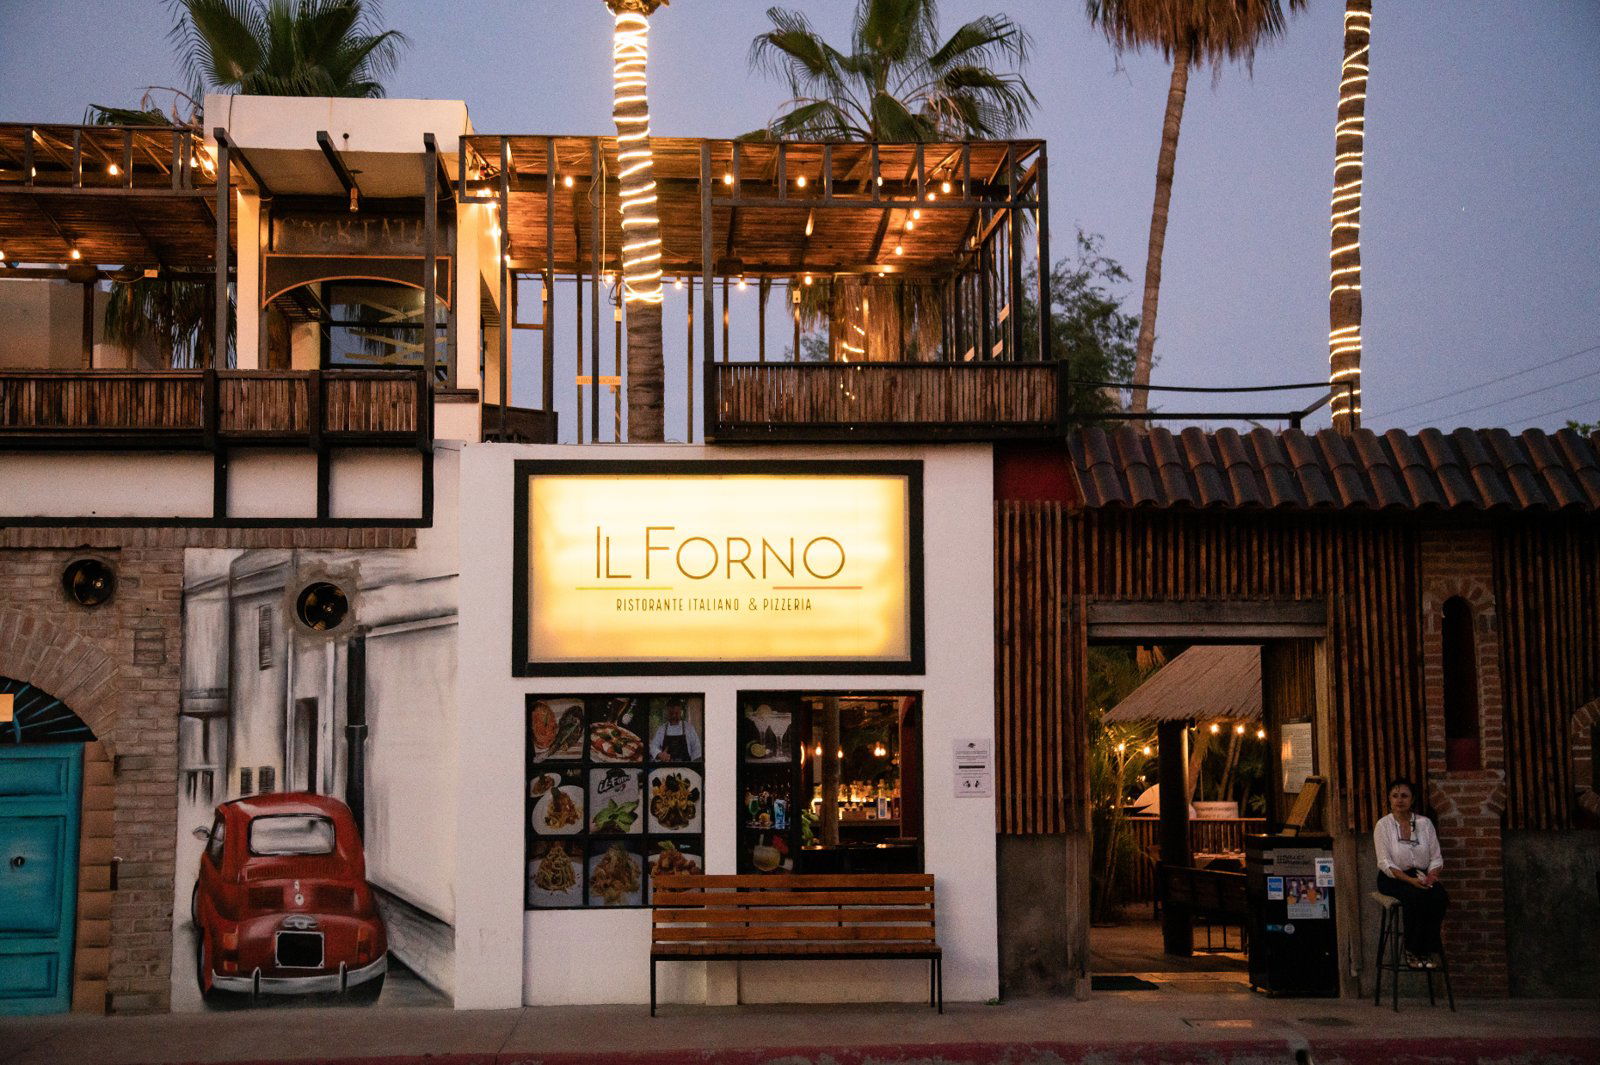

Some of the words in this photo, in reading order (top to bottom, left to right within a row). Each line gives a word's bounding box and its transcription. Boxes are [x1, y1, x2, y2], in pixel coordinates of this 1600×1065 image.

[596, 526, 632, 579] IL
[645, 526, 846, 580] FORNO
[616, 598, 684, 612] RISTORANTE
[688, 598, 740, 611] ITALIANO
[748, 597, 758, 611] &
[763, 598, 812, 611] PIZZERIA
